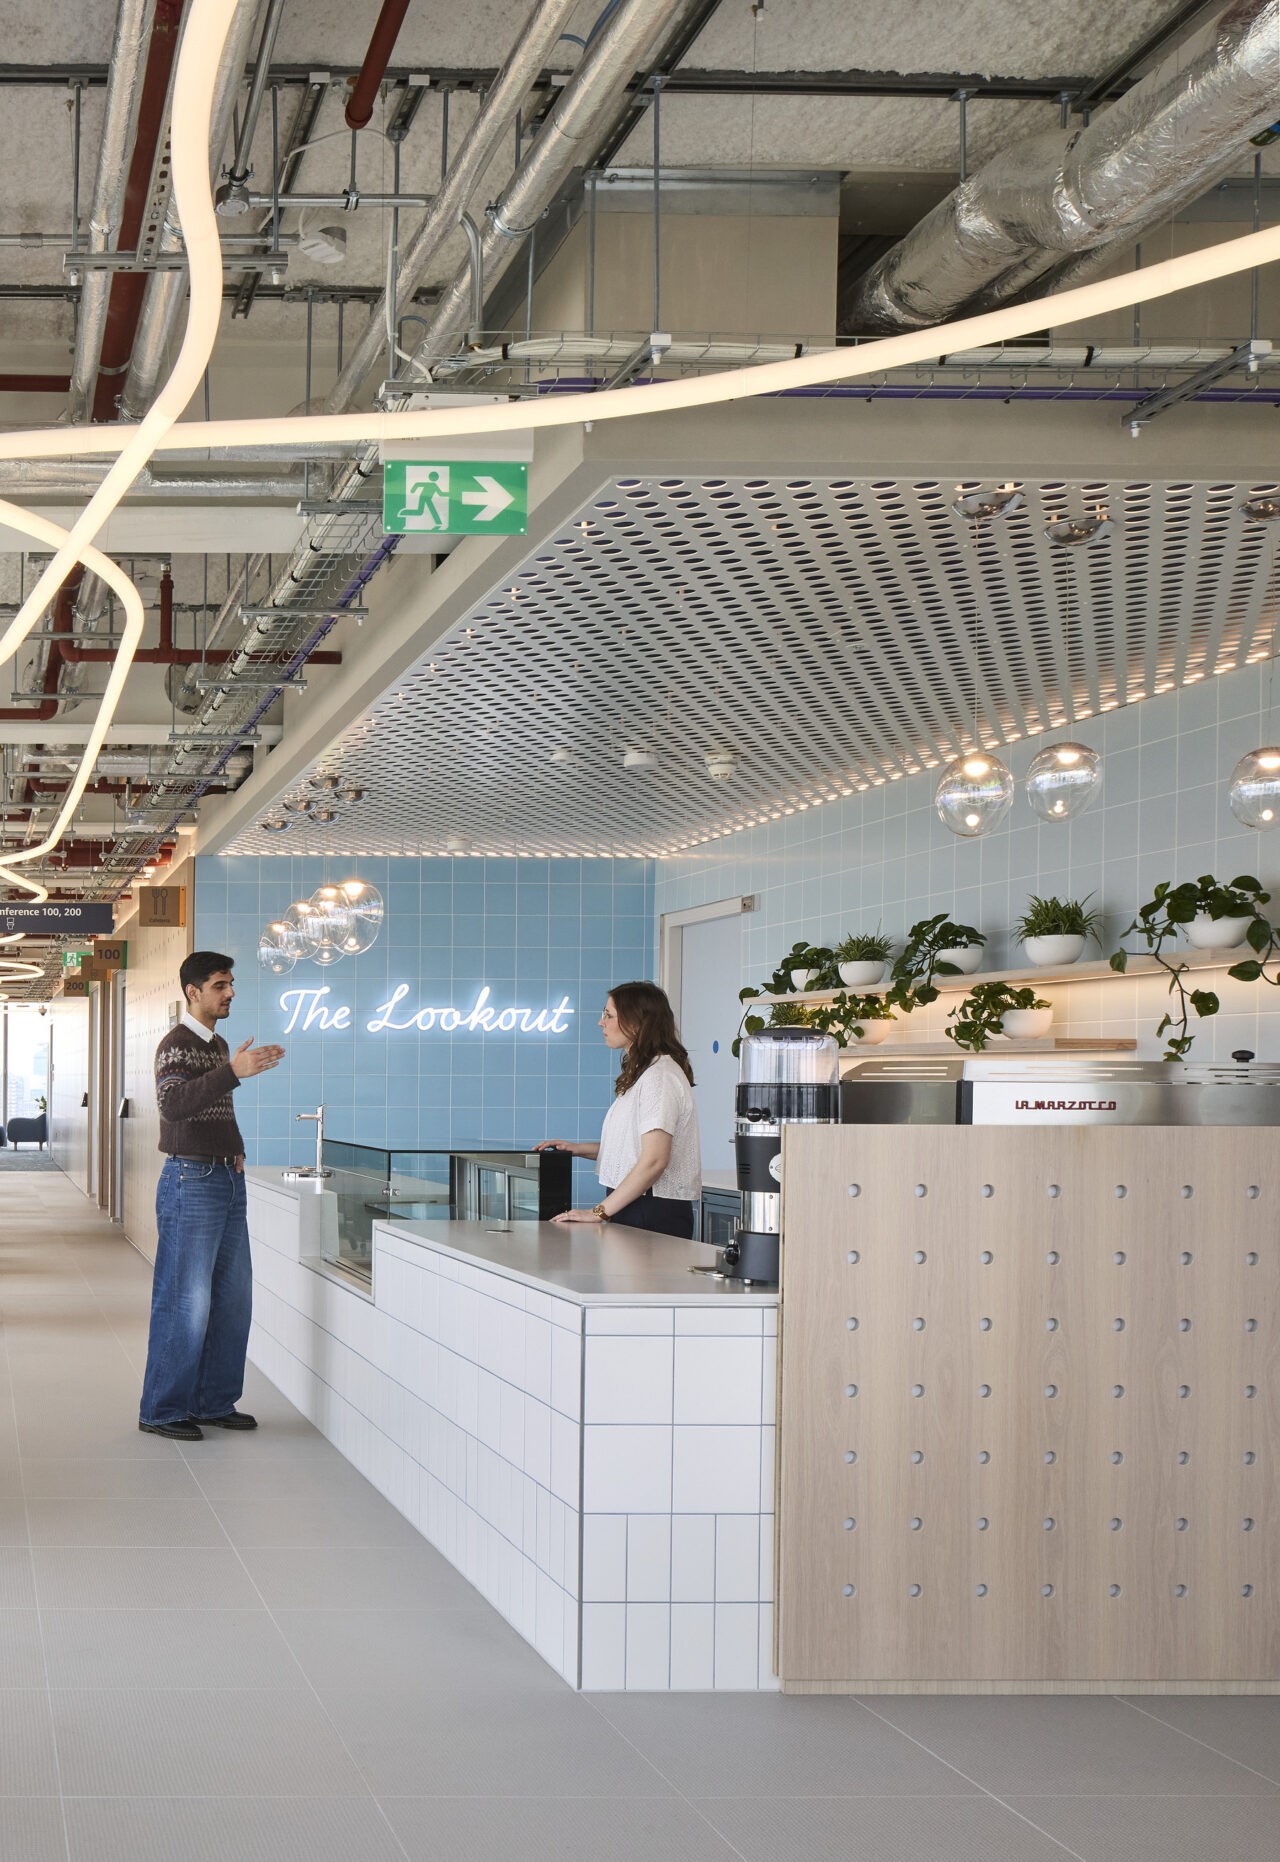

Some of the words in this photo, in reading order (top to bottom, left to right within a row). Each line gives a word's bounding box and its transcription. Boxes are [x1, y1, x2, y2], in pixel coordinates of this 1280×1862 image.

[42, 908, 62, 918] 100,
[64, 908, 82, 916] 200
[97, 949, 121, 960] 100
[66, 982, 84, 991] 200
[279, 986, 352, 1034] The
[367, 983, 575, 1033] Lookout
[1015, 1100, 1029, 1110] LA
